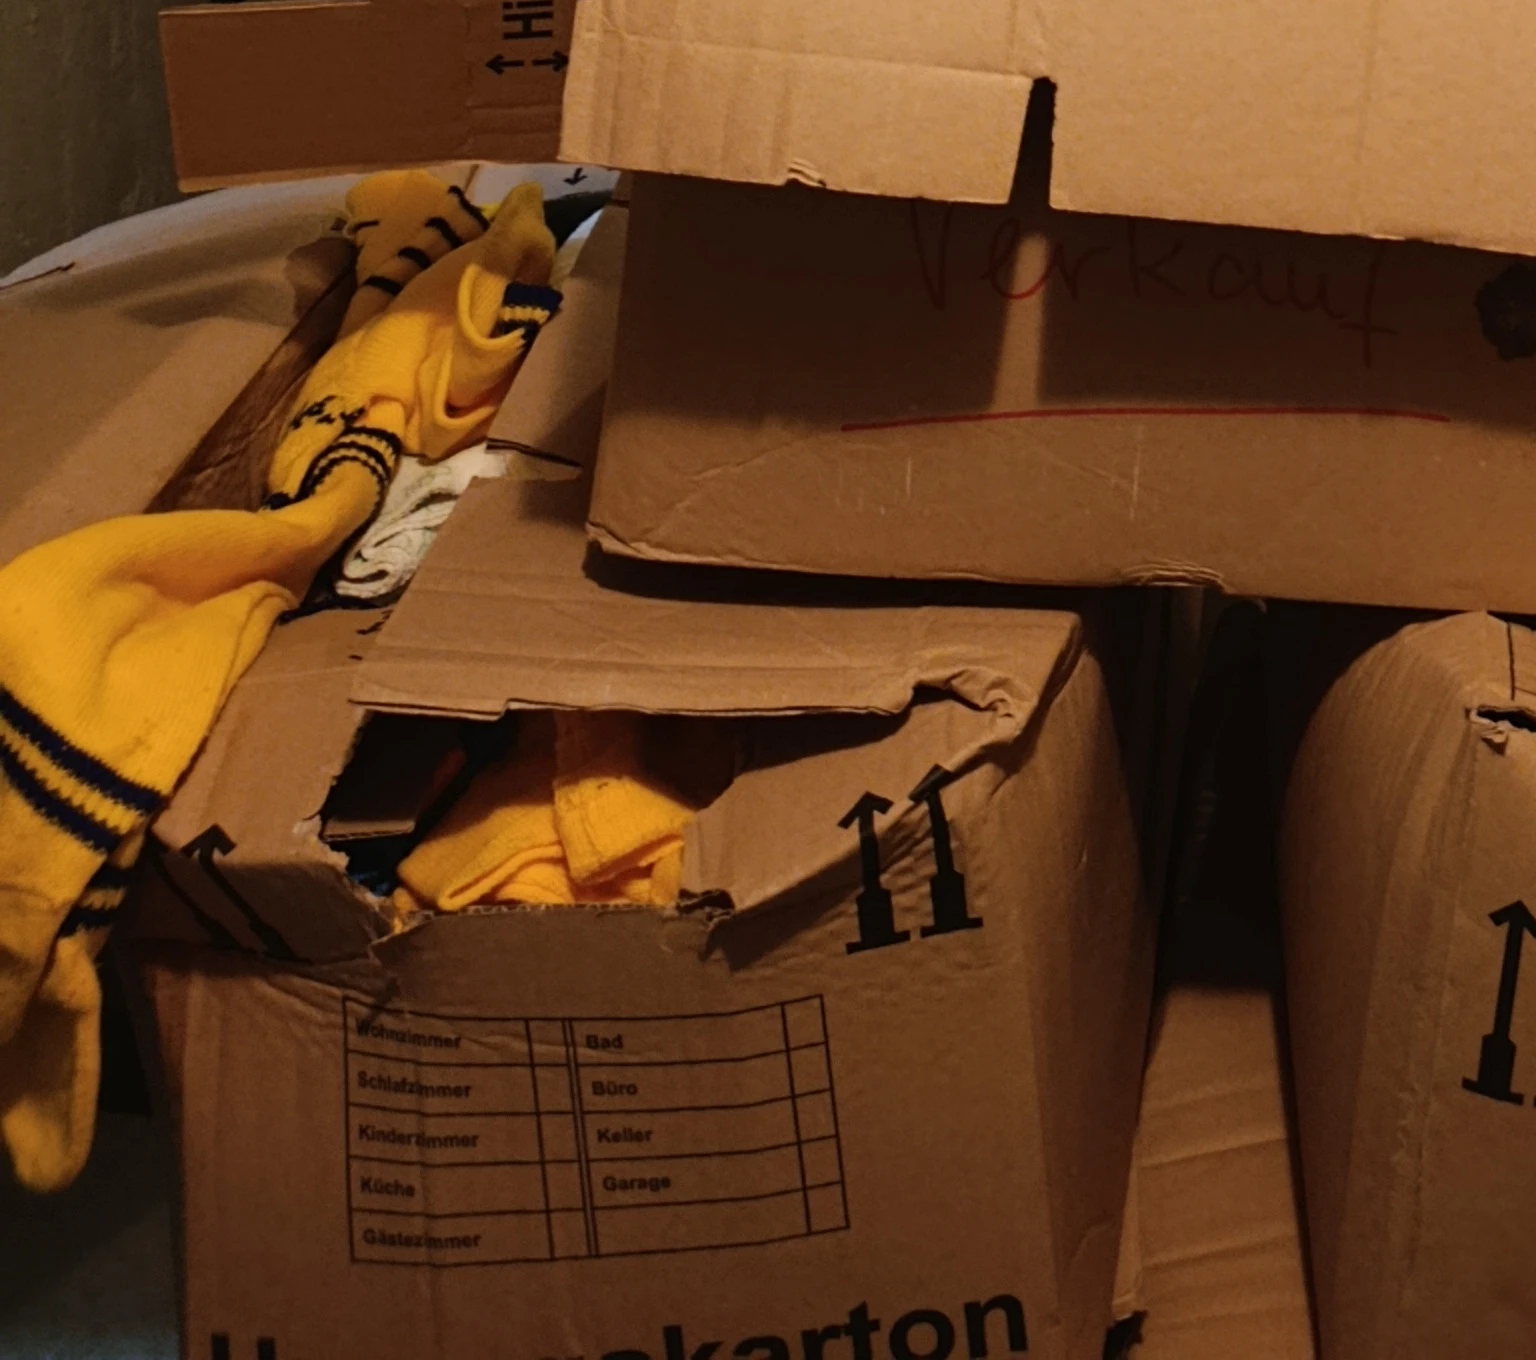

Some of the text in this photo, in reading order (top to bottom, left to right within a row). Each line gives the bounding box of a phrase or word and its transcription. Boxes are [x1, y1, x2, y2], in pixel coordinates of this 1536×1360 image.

[356, 1018, 461, 1049] Wohnzimmer
[585, 1034, 623, 1050] Bad
[357, 1070, 473, 1099] Schlafzimmer
[592, 1081, 638, 1097] Büro
[597, 1128, 652, 1144] Keller
[360, 1176, 415, 1198] Küche
[602, 1175, 671, 1193] Garage
[362, 1228, 481, 1250] Gästezimmer
